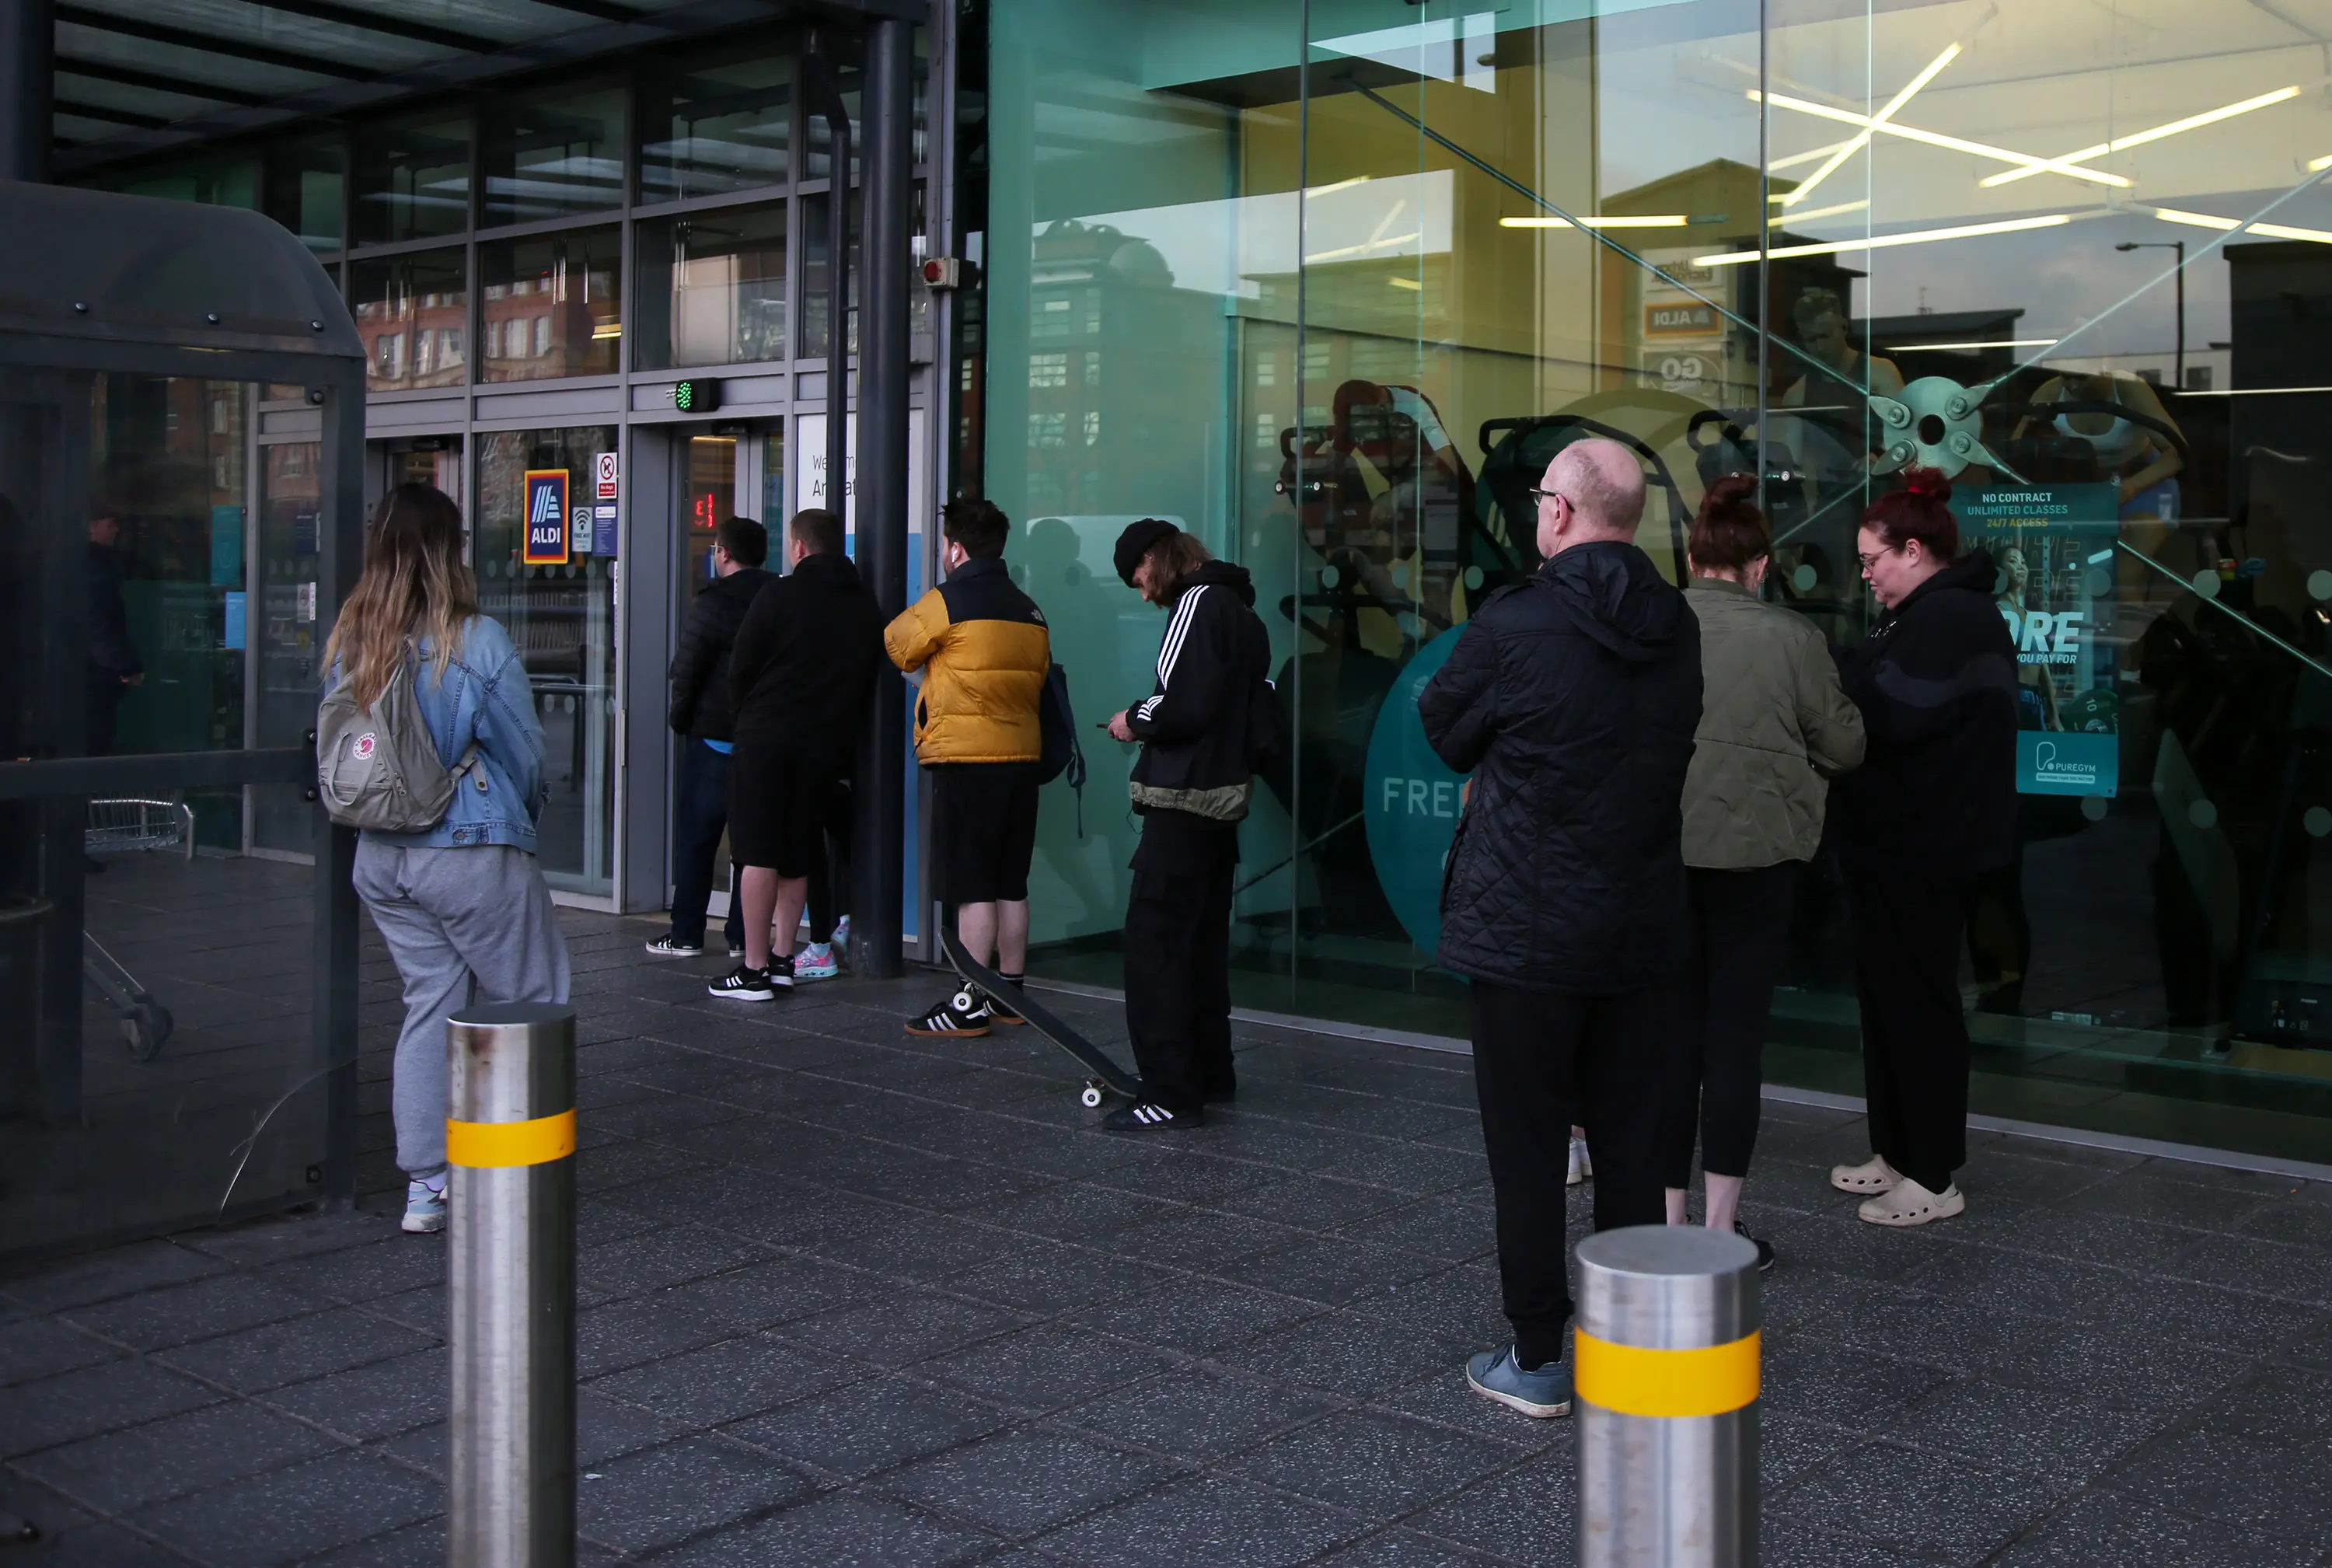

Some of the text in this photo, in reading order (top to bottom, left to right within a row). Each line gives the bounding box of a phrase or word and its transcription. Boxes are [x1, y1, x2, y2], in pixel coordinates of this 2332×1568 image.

[1982, 492, 2052, 503] NO CONTRACT
[1967, 505, 2068, 515] UNLIMITED CLASSES
[1987, 518, 2049, 528] 24/7 ACCESS
[531, 527, 561, 543] ALDI
[2036, 654, 2055, 663] PAY
[2056, 655, 2077, 664] FOR
[2055, 763, 2096, 773] PUREGYM
